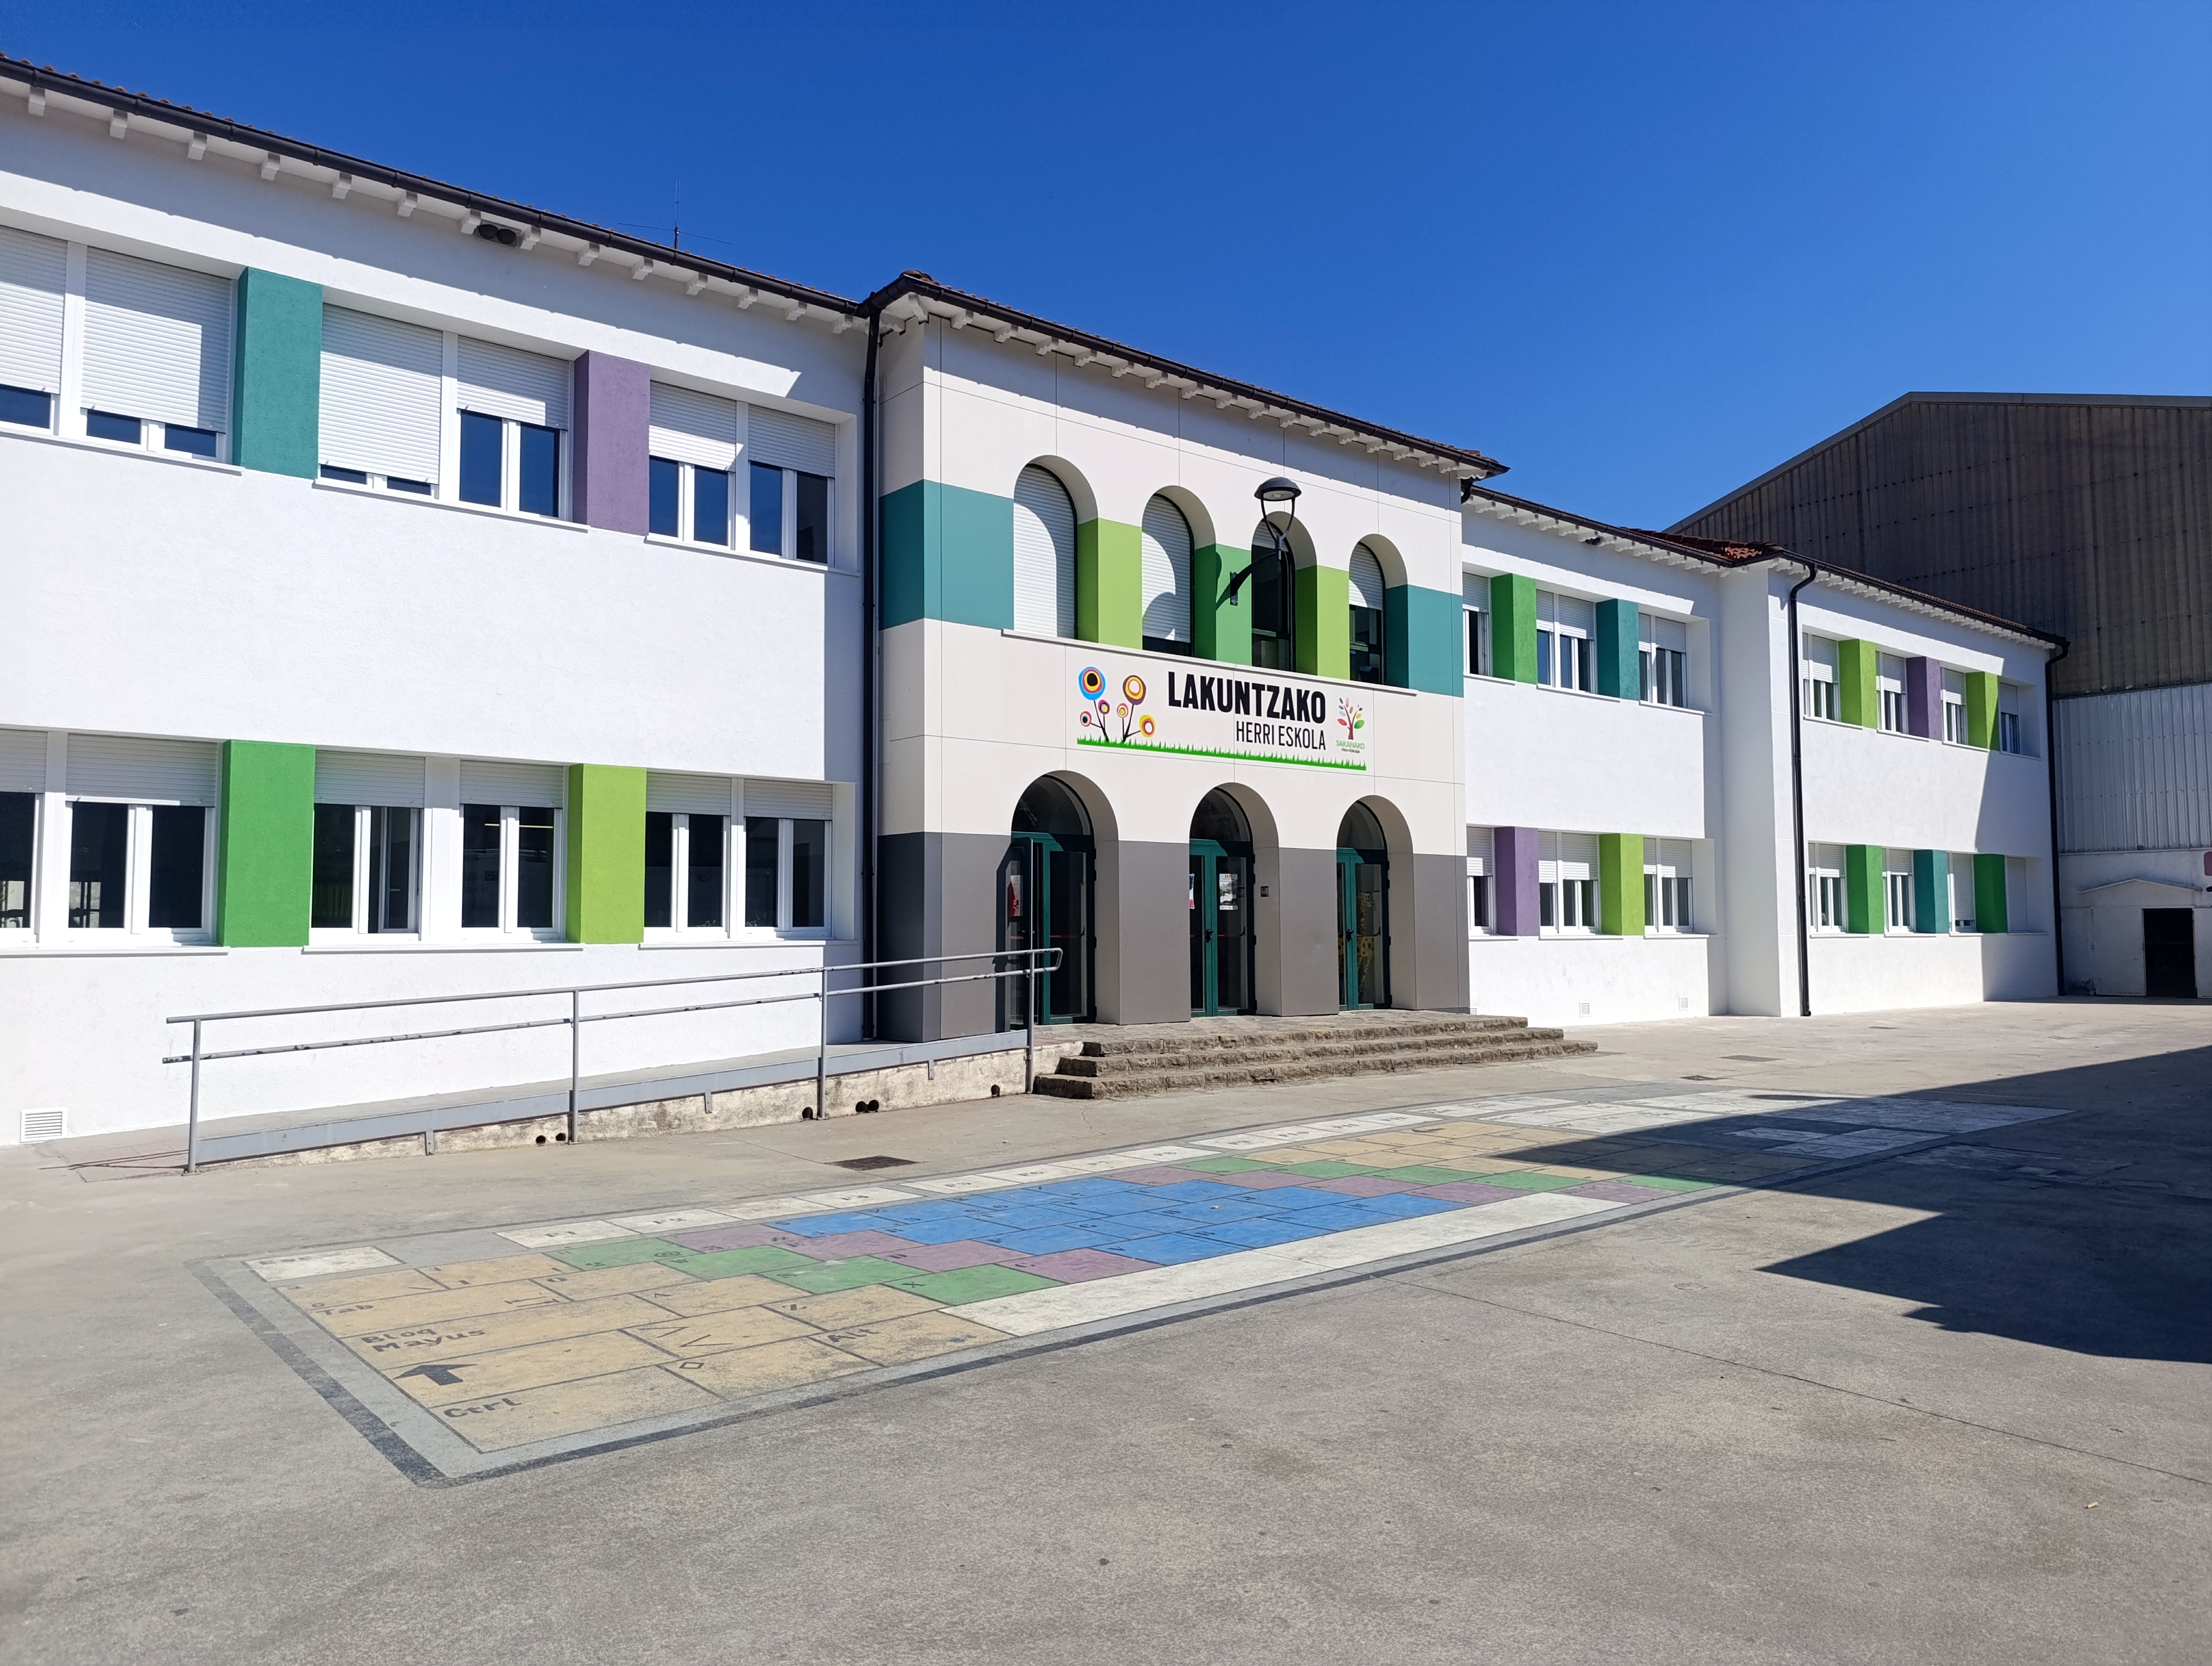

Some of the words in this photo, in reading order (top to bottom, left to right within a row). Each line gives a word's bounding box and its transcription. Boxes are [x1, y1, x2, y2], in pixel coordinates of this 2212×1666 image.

[1168, 671, 1326, 724] LAKUNTZAKO
[1236, 721, 1274, 745] HERRI
[1278, 725, 1326, 751] ESKOLA
[1336, 740, 1365, 749] SAKANAKO
[259, 1256, 312, 1265] Esc
[316, 1305, 374, 1316] Tab
[360, 1328, 438, 1344] Bloq
[372, 1329, 486, 1352] Mayus
[827, 1329, 880, 1342] Alt
[443, 1398, 523, 1418] Ctrl
